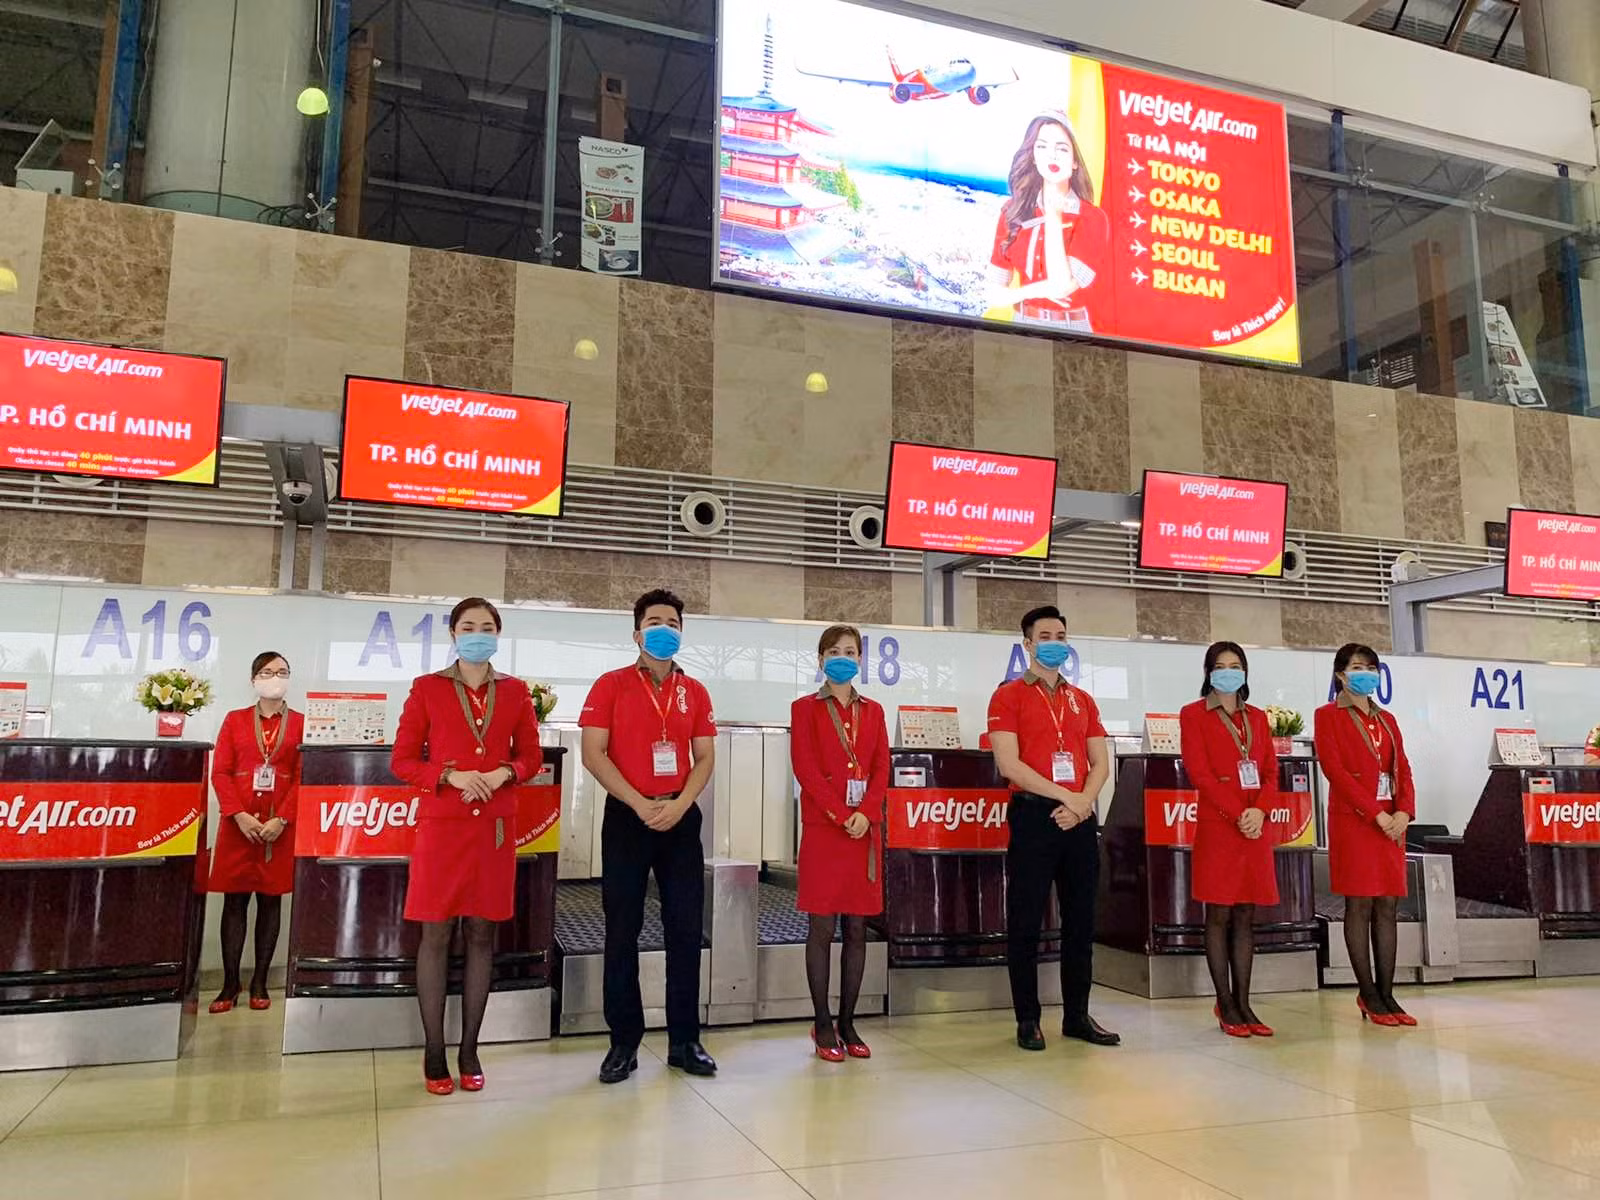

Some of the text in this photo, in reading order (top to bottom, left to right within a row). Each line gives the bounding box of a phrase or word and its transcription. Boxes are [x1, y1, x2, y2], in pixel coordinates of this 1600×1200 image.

[1145, 134, 1171, 154] HÀ
[1174, 141, 1207, 164] NỘI
[1148, 160, 1221, 192] TOKYO
[1150, 187, 1221, 218] OSAKA
[1151, 214, 1272, 254] NEW DELHI
[1151, 241, 1220, 271] SEOUL
[1153, 268, 1226, 299] BUSAN
[1212, 329, 1231, 342] Bay
[75, 411, 118, 433] CHÍ
[124, 417, 192, 440] MINH
[80, 450, 91, 459] 40
[369, 443, 398, 462] TP.
[443, 450, 478, 470] CHÍ
[484, 455, 541, 476] MINH
[908, 499, 929, 515] TP.
[962, 503, 988, 519] CHÍ
[992, 507, 1035, 524] MINH
[1159, 523, 1178, 537] TP.
[1206, 525, 1230, 541] CHÍ
[1233, 529, 1270, 545] MINH
[1522, 555, 1537, 567] TP.
[1559, 556, 1577, 571] CHÍ
[80, 598, 212, 661] A16
[1005, 643, 1080, 687] A9
[1470, 667, 1524, 710] A21
[137, 839, 153, 848] Bay
